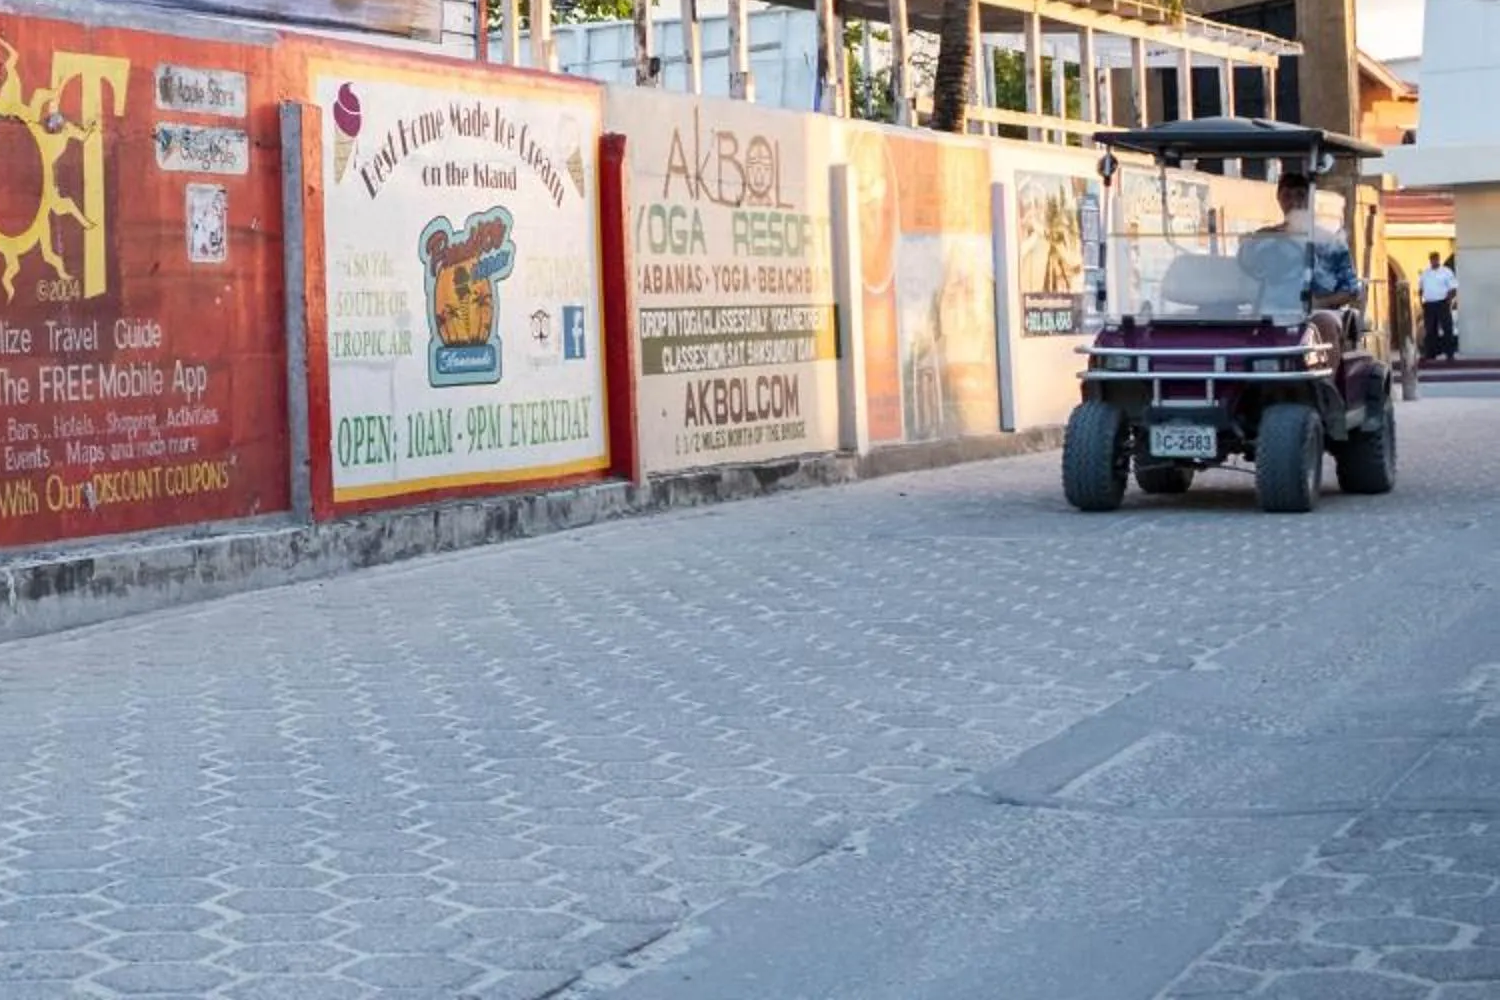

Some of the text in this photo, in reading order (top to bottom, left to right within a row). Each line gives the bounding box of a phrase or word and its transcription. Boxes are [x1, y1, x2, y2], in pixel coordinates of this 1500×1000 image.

[449, 101, 491, 137] Made
[495, 107, 515, 149] Ice
[519, 124, 565, 208] Cream
[422, 161, 517, 191] on the Island
[637, 264, 700, 294] ABANAS
[712, 264, 750, 293] YOGA
[758, 264, 800, 294] BEACH
[336, 290, 386, 317] SOUTH
[45, 320, 99, 352] Travel
[114, 318, 162, 350] Guide
[641, 312, 666, 337] DROP
[679, 311, 702, 335] YOGA
[704, 309, 744, 334] CLASSES
[332, 329, 413, 357] TROPIC AIR
[662, 345, 707, 372] CLASSES
[39, 364, 94, 403] FREE
[99, 362, 164, 399] Mobile
[172, 359, 207, 402] App
[166, 404, 220, 427] Activities
[337, 415, 397, 467] OPEN:
[407, 408, 453, 459] 10AM
[467, 403, 502, 455] 9PM
[509, 396, 591, 447] EVERYDAY
[702, 429, 726, 450] MILES
[4, 444, 51, 471] Events
[66, 440, 105, 471] Maps
[111, 441, 134, 461] and
[168, 436, 198, 453] more
[46, 474, 85, 512] Our
